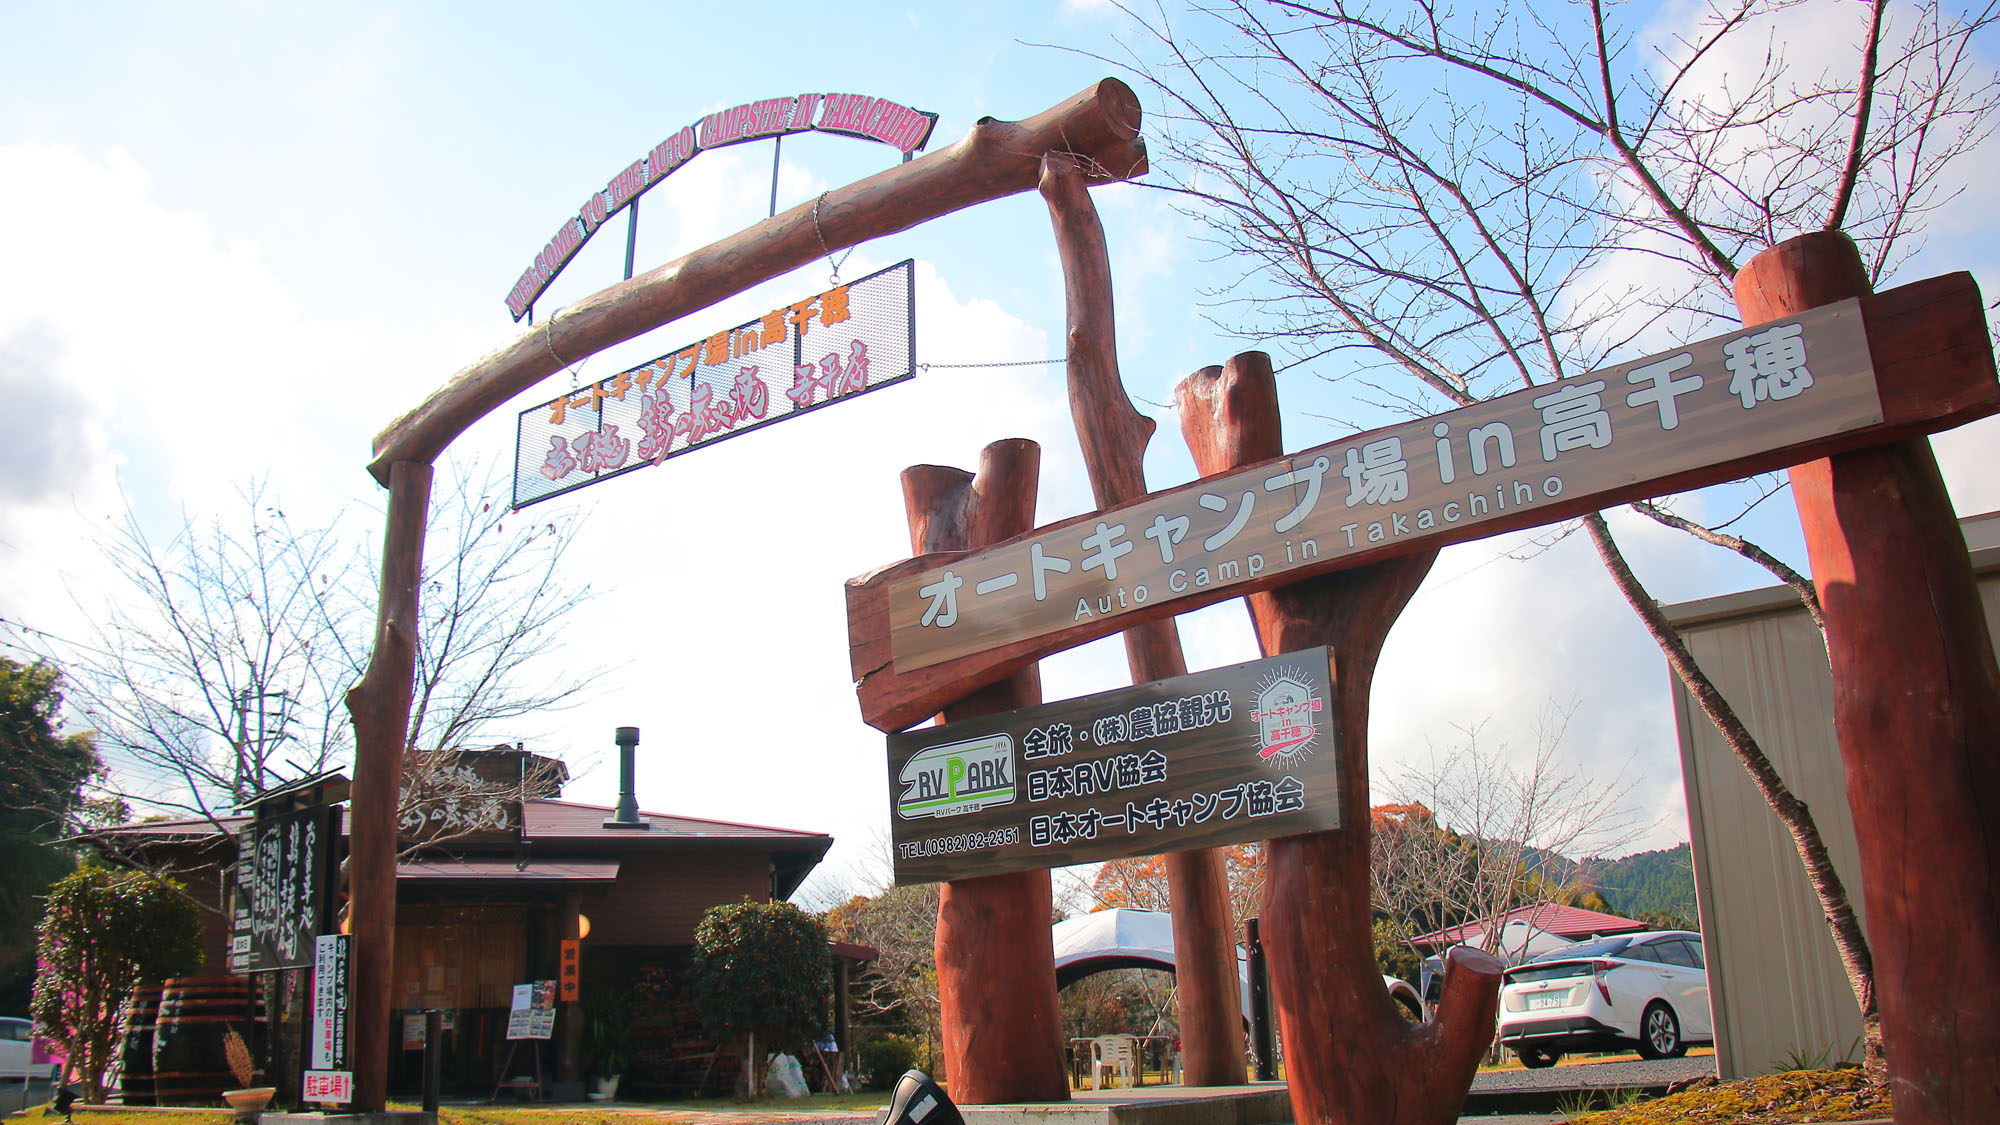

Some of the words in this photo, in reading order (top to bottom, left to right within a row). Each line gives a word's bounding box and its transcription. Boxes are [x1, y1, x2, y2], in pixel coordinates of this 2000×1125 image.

[505, 217, 584, 318] WELCOME
[580, 192, 607, 233] TO
[607, 159, 646, 211] THE
[648, 126, 695, 179] AUTO
[700, 96, 796, 150] CAMPSITE
[790, 93, 823, 130] IN
[817, 93, 931, 152] TAKACHIHO
[549, 285, 851, 425] オートキャンプ場in高千穂
[918, 322, 1815, 629] オートキャンプ場in高千穂
[1074, 585, 1149, 622] Auto
[1169, 552, 1265, 594] Camp
[1286, 538, 1319, 564] in
[1340, 474, 1564, 549] Takachiho
[1251, 697, 1322, 723] オートキャンプ場
[1270, 726, 1302, 741] 高千穂
[1282, 717, 1292, 726] in
[1027, 750, 1166, 803] 日本RV協会
[1029, 775, 1304, 847] 日本オートキャンプ協会
[899, 826, 1021, 859] TEL(0982)82-2351
[306, 1075, 342, 1097] 駐車場
